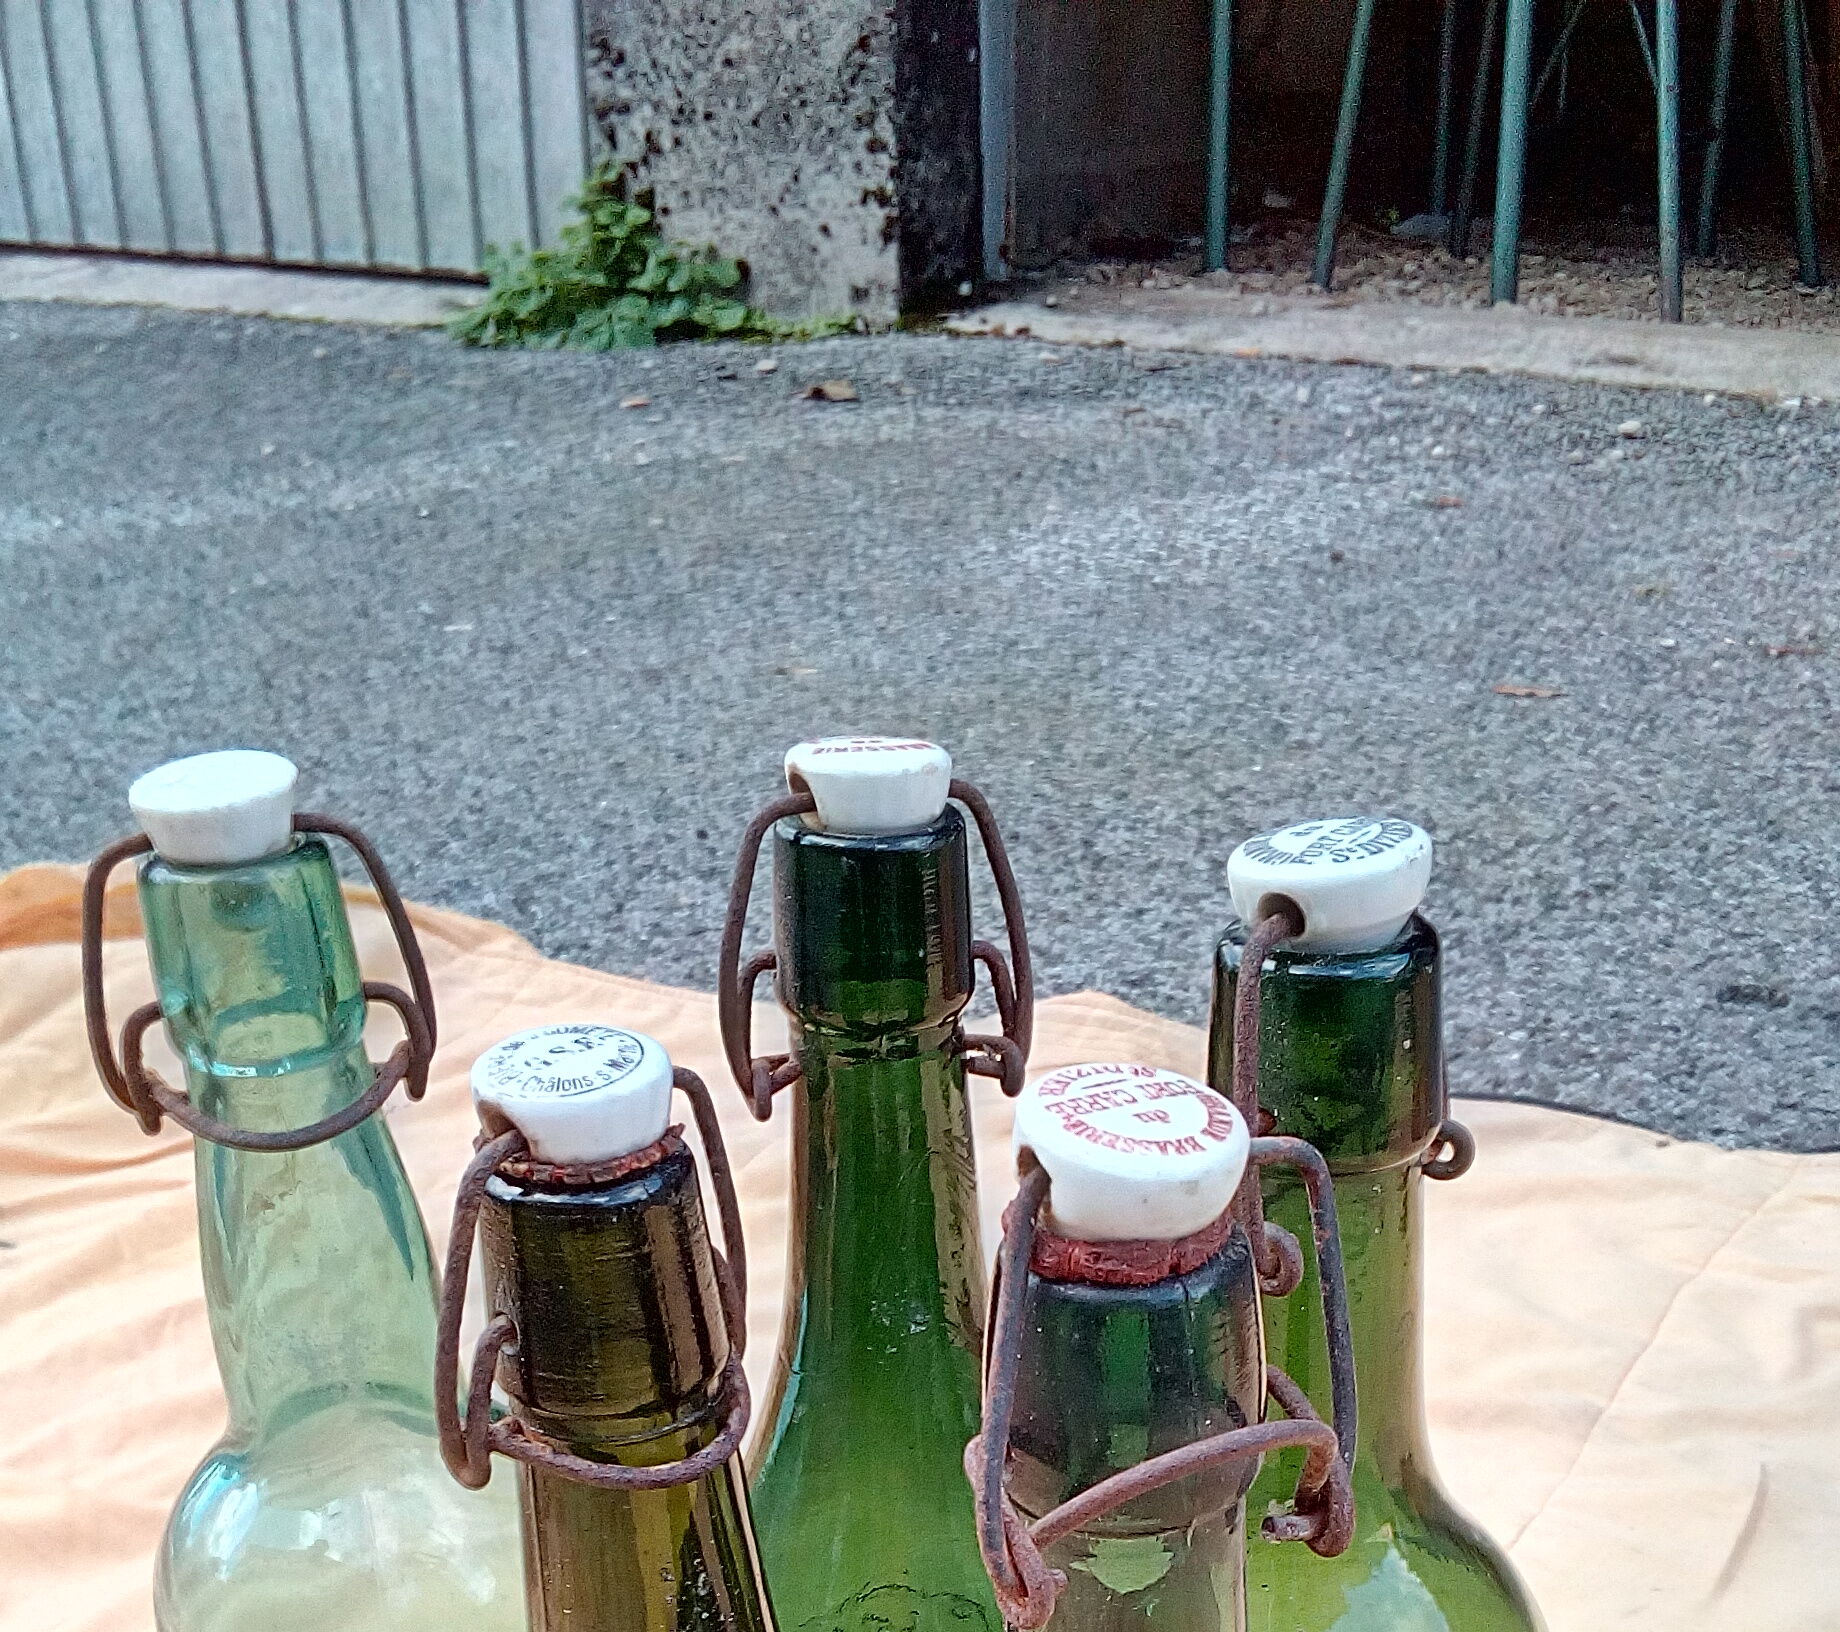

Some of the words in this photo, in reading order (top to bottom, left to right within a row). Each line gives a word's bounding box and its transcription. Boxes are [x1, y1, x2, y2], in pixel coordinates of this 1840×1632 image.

[1134, 1079, 1204, 1100] FORT
[1131, 1108, 1171, 1124] du
[1062, 1119, 1208, 1156] BRASSERIE
